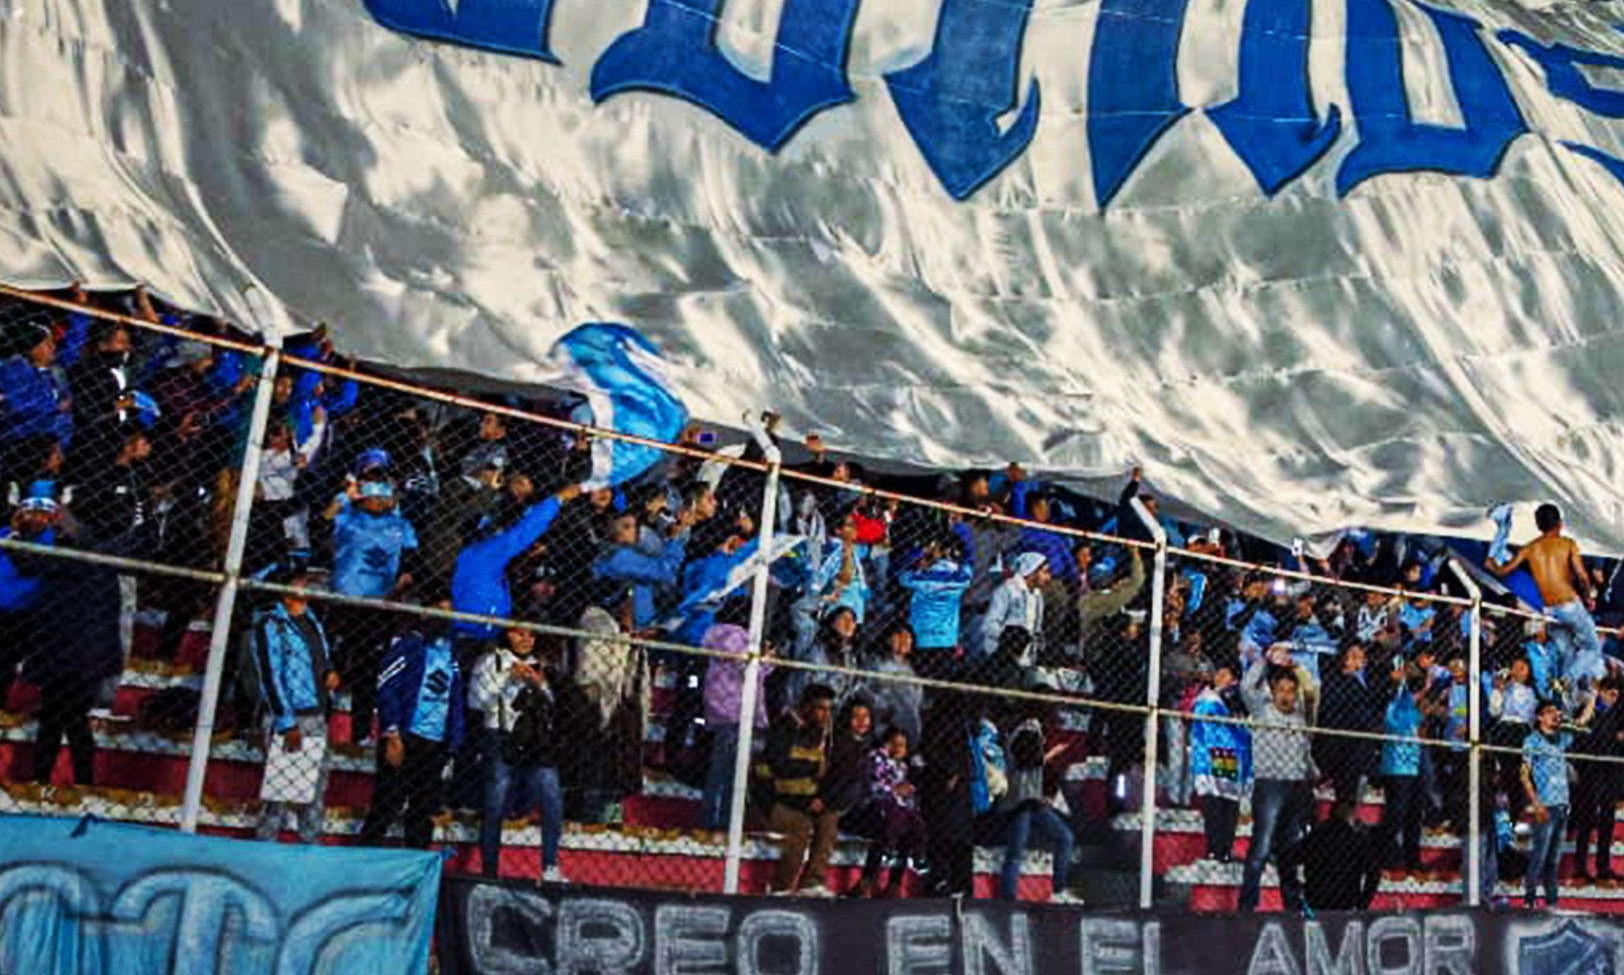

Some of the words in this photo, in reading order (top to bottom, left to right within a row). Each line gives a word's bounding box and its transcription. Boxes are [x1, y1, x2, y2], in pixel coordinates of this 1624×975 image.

[467, 883, 820, 975] CREO
[886, 913, 1034, 975] EN
[1246, 913, 1477, 975] AMOR
